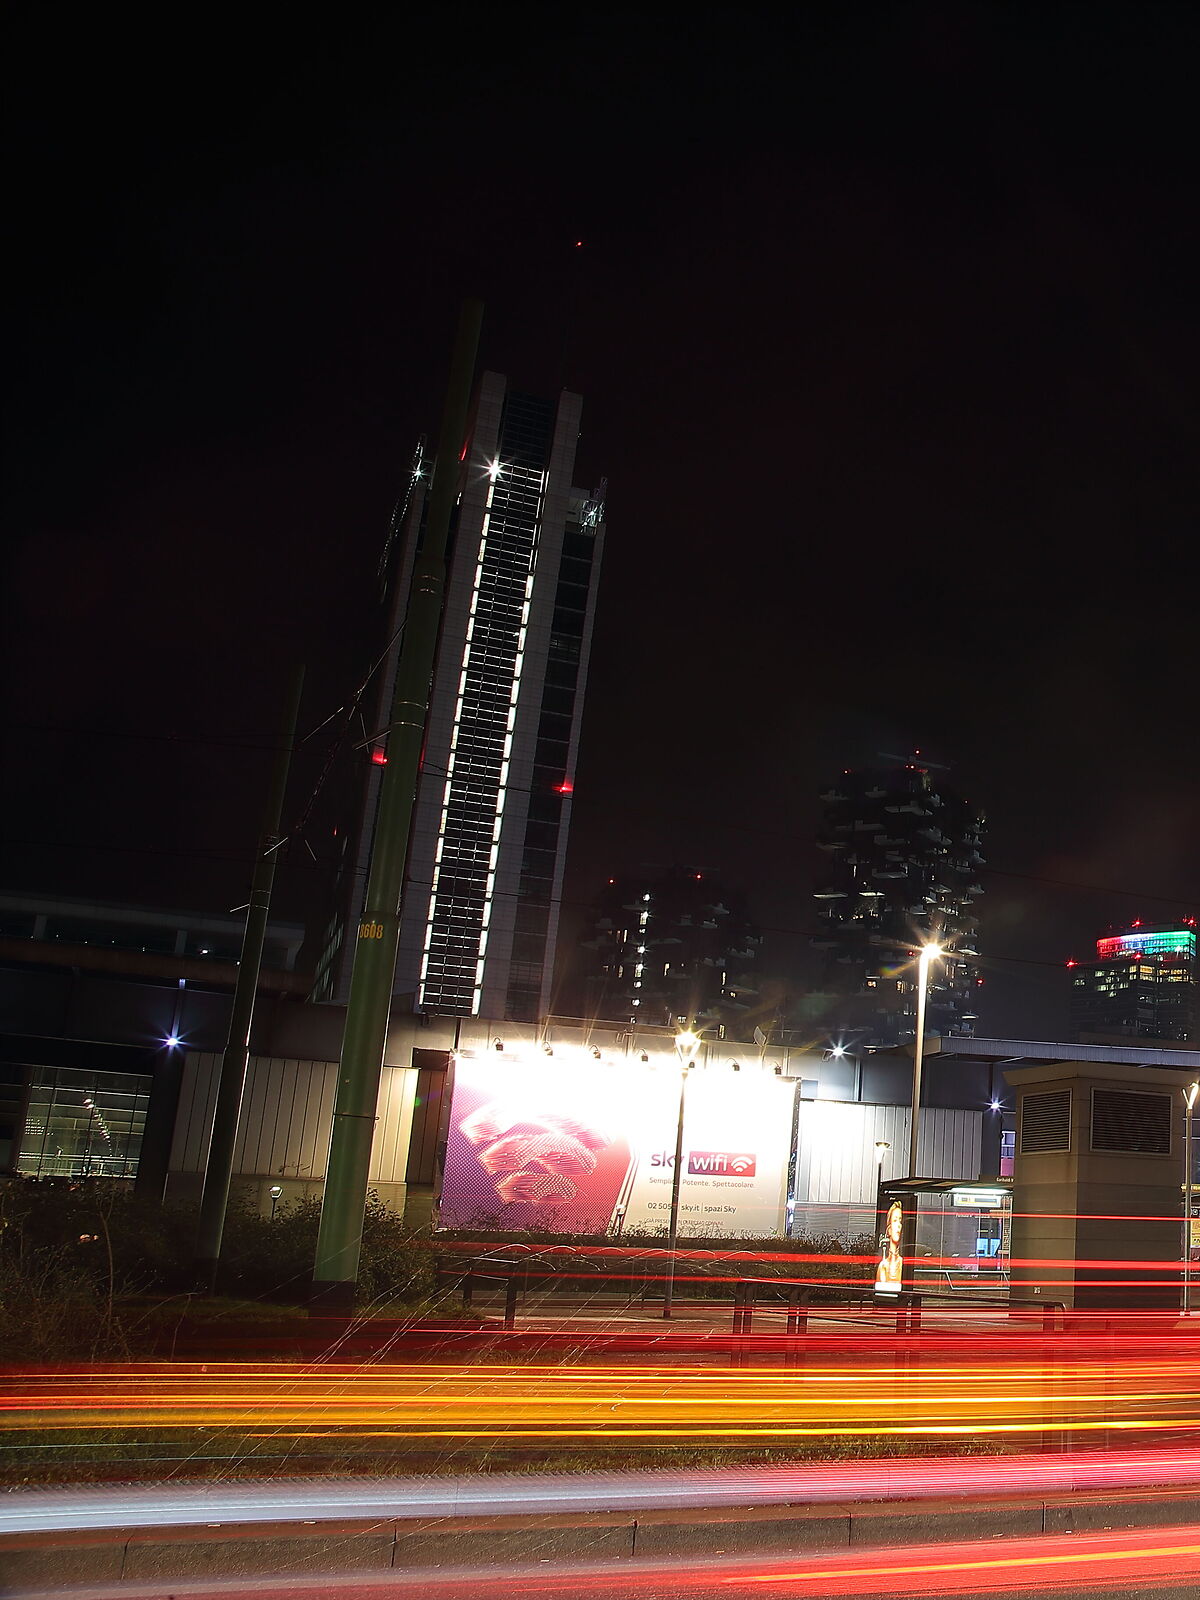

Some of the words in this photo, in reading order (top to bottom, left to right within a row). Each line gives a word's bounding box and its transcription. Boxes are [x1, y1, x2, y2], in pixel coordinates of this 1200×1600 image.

[692, 1154, 728, 1171] wifi
[682, 1178, 710, 1188] Potente.
[647, 1202, 657, 1210] 02
[681, 1204, 700, 1212] sky.it
[704, 1205, 723, 1214] spazi
[723, 1205, 737, 1214] Sky
